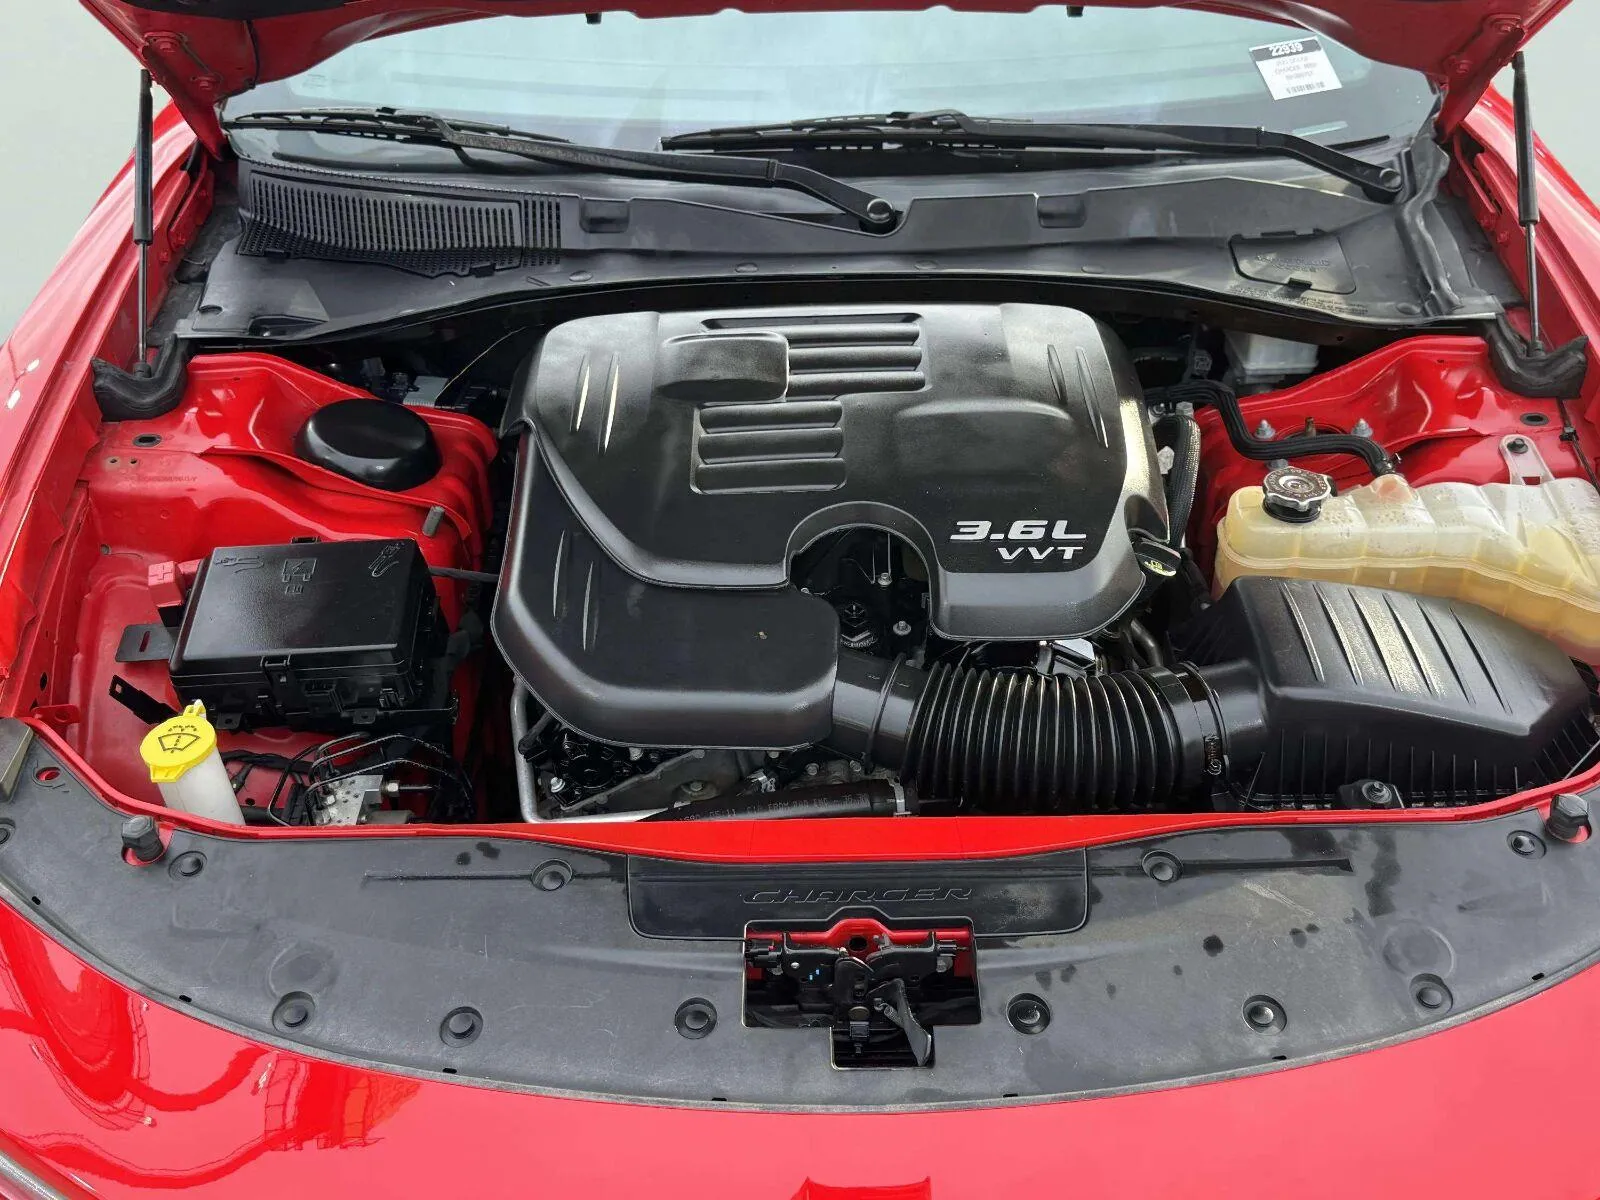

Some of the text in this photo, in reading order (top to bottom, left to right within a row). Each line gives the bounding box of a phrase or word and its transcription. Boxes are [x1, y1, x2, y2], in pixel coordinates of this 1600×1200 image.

[1269, 42, 1304, 56] 22939
[950, 520, 1087, 541] 3.6L
[997, 546, 1083, 561] VVT
[743, 887, 973, 904] CHARGER
